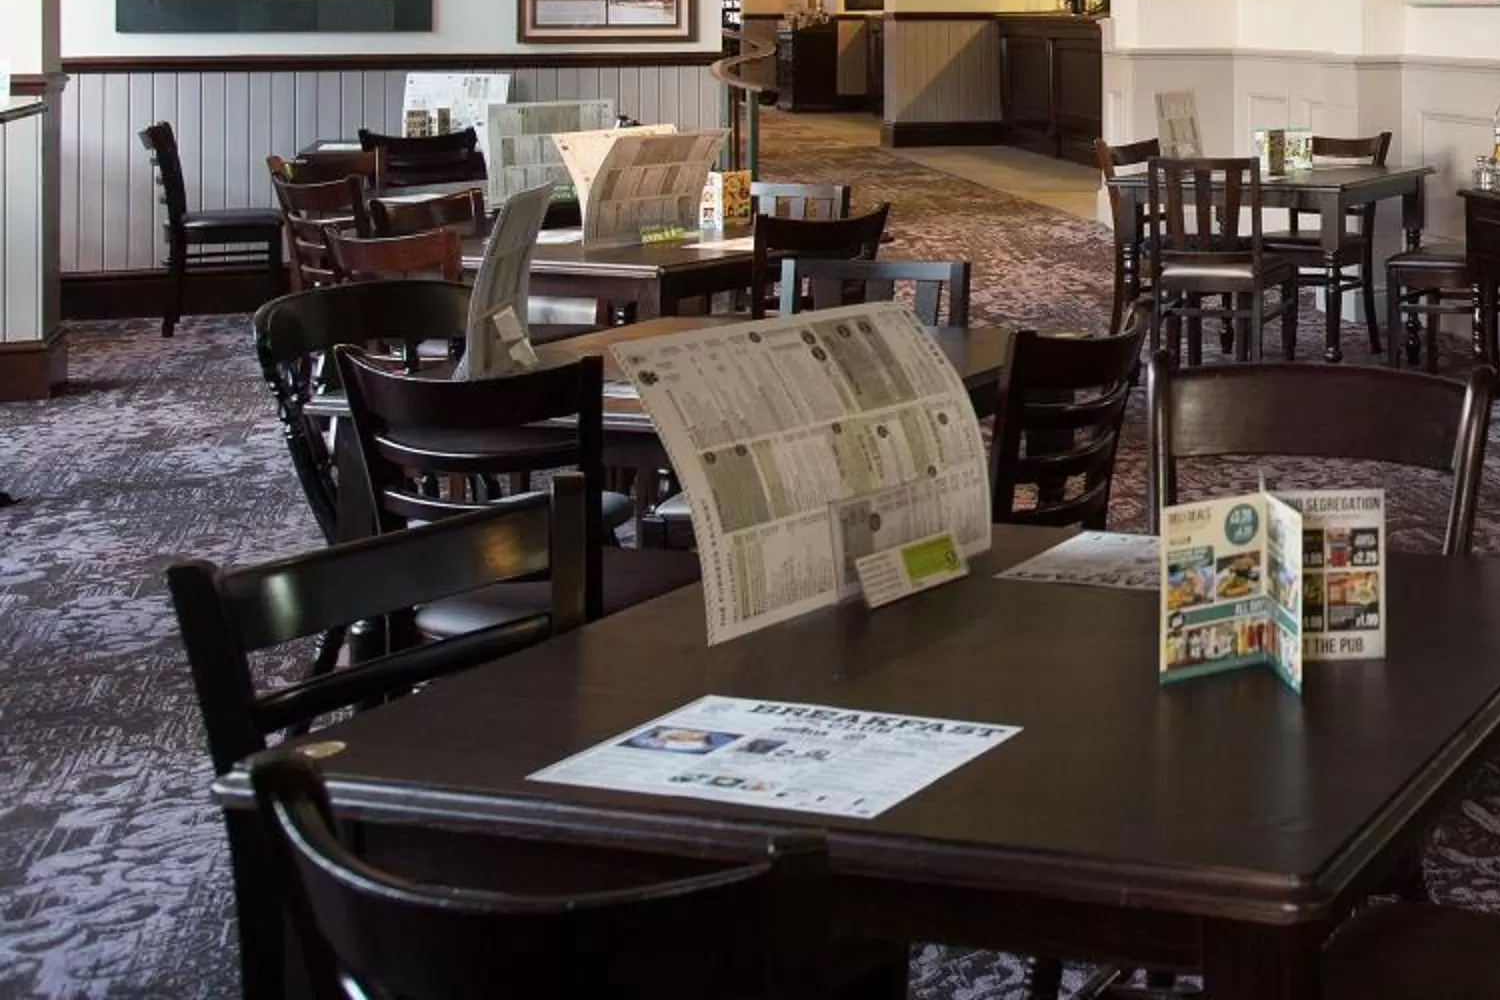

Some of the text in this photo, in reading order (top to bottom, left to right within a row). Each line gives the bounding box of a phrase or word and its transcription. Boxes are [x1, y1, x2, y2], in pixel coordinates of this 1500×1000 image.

[1314, 636, 1337, 654] THE
[1340, 635, 1364, 654] PUB
[749, 703, 1006, 738] BREAKFAST
